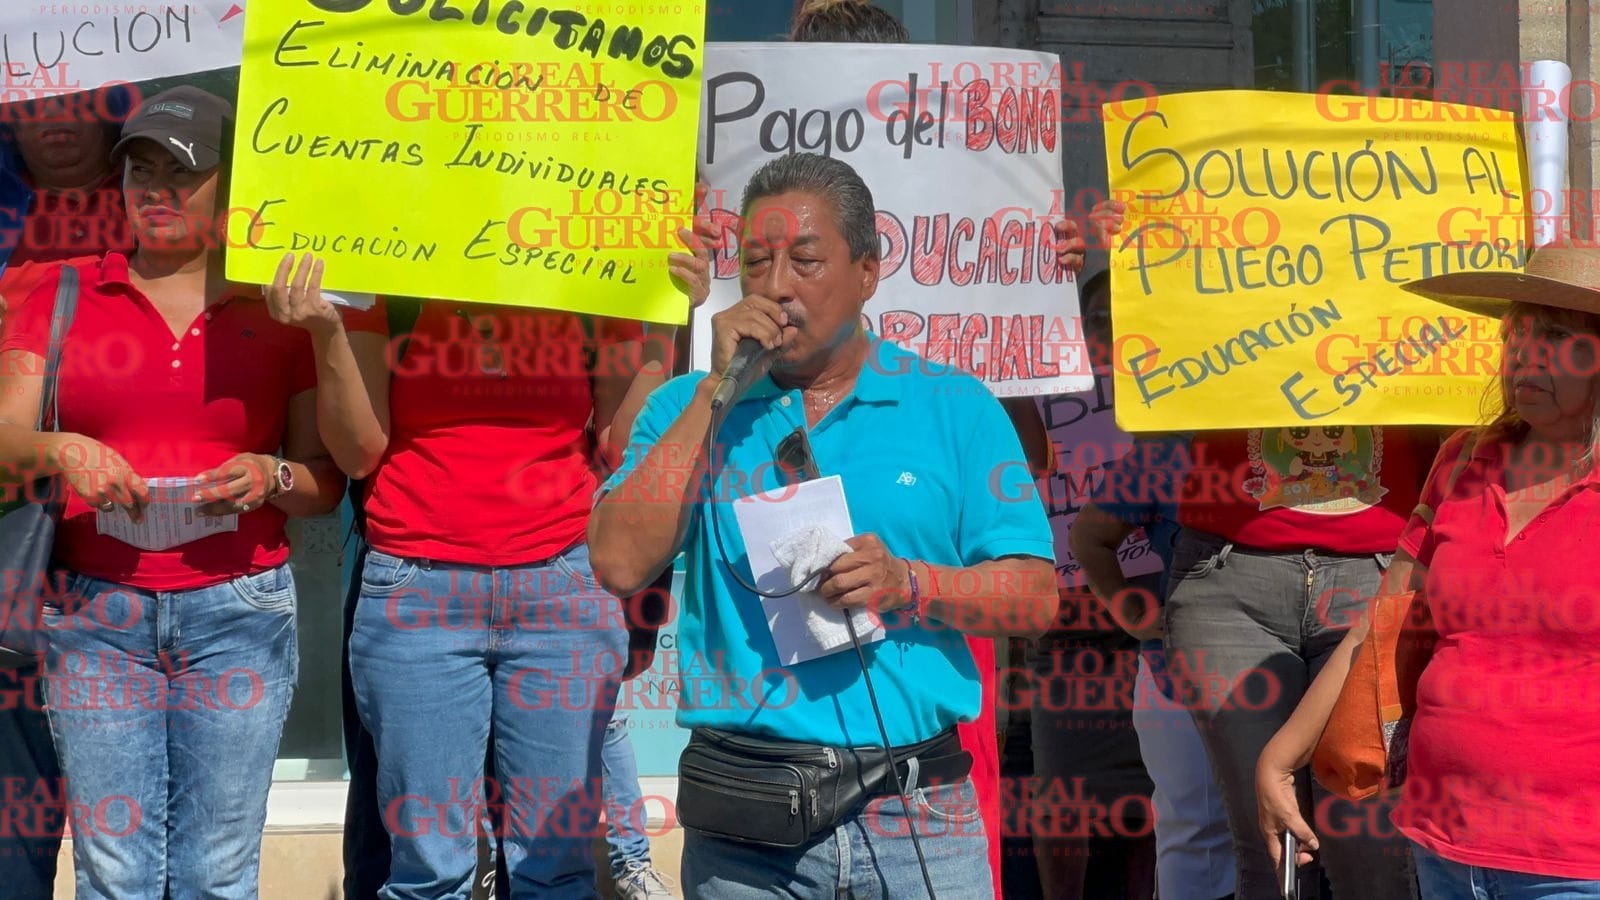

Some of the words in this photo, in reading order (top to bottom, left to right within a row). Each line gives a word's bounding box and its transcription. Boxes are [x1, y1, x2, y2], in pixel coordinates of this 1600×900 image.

[0, 4, 190, 76] LUCION
[252, 97, 424, 166] CUENTAS
[594, 84, 643, 110] DE
[707, 71, 864, 164] Pago
[886, 72, 949, 160] del
[960, 78, 1058, 154] BONO
[1122, 111, 1438, 203] SOLUCIÓN
[1462, 145, 1520, 199] AL
[1118, 222, 1323, 295] PLIEGO
[1127, 298, 1343, 409] EDUCACIÓN
[1280, 315, 1468, 420] ESPECIAL
